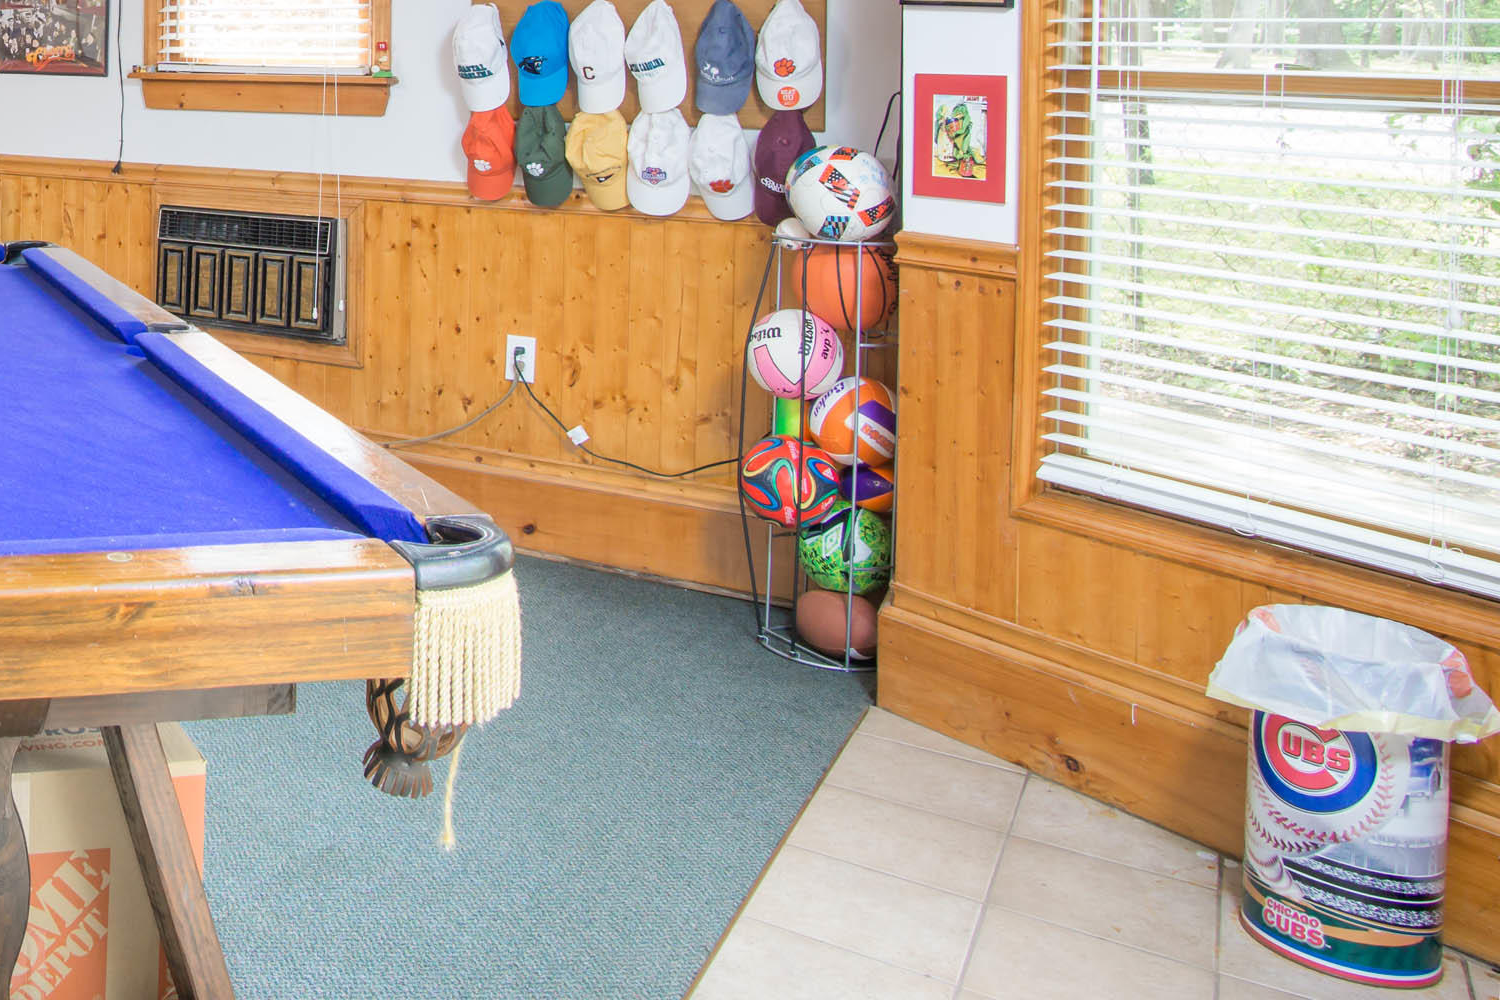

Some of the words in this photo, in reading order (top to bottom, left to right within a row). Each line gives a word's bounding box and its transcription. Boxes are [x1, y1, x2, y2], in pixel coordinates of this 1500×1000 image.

[583, 66, 595, 80] C
[1262, 908, 1325, 950] CUBS
[1266, 898, 1320, 929] CHICAGO
